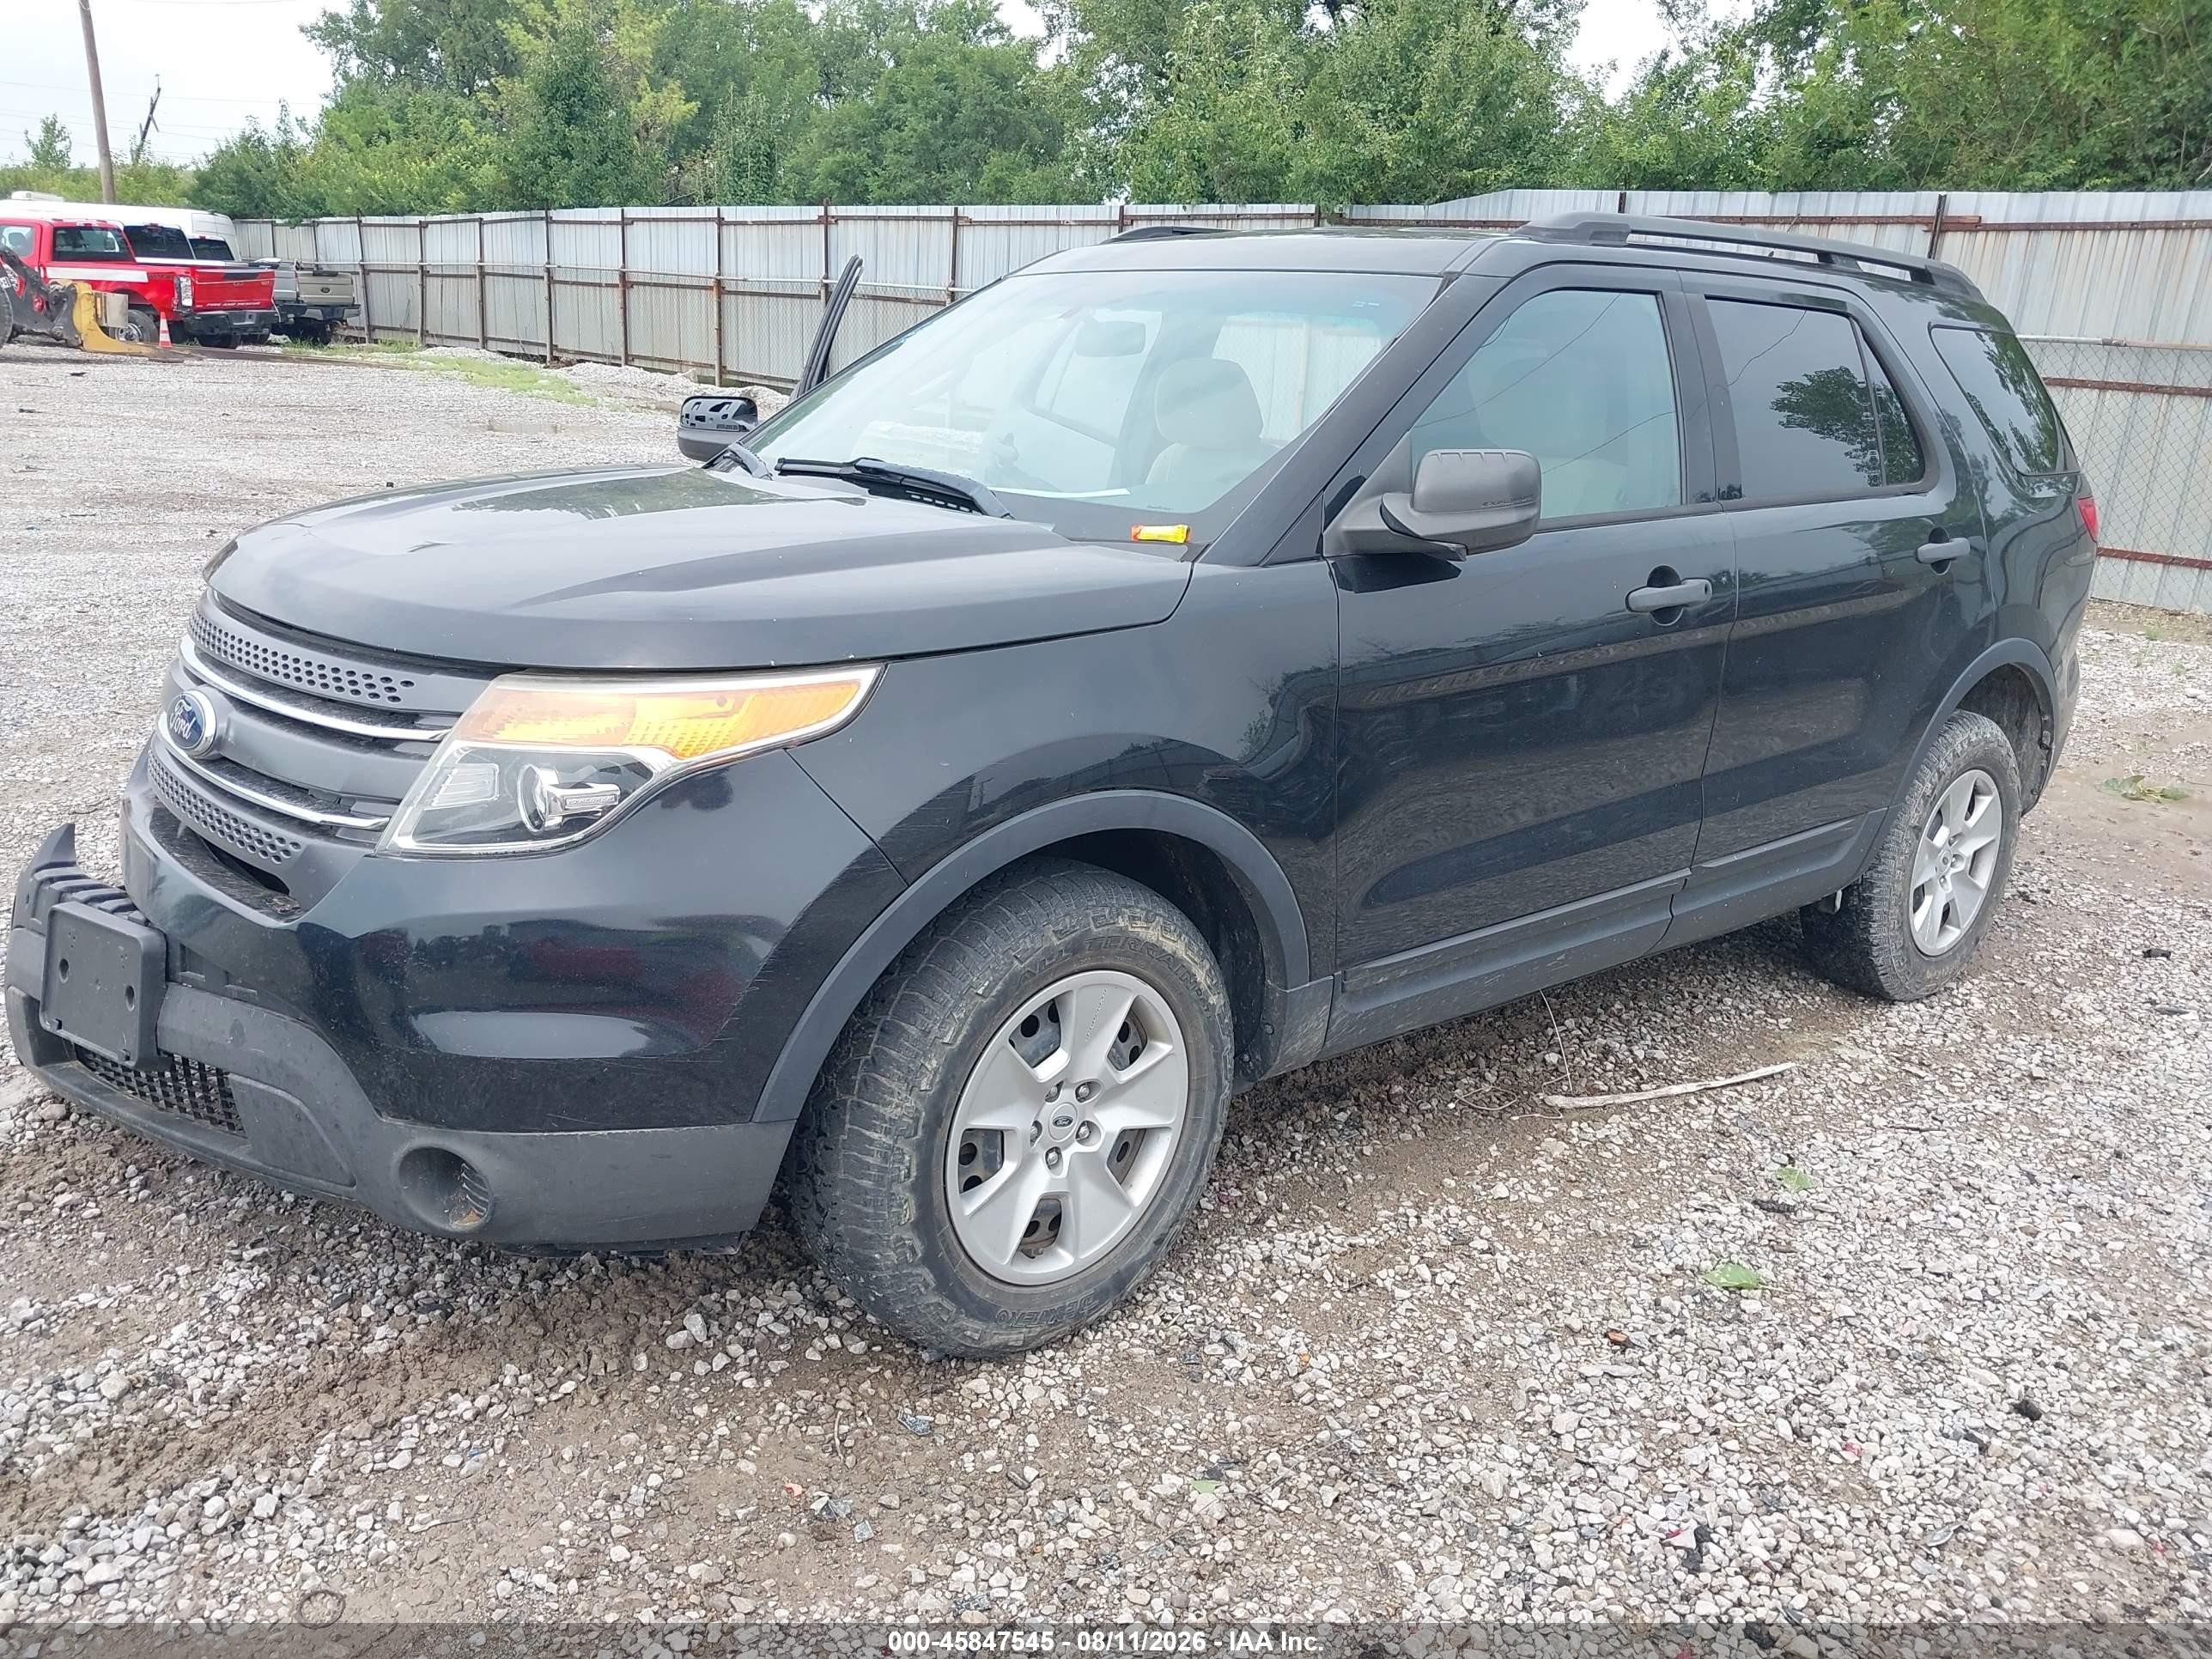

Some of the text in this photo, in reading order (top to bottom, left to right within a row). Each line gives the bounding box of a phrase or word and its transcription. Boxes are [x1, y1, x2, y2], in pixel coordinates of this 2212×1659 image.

[170, 699, 197, 739] Ford
[1018, 935, 1198, 991] ALL TERRAIN
